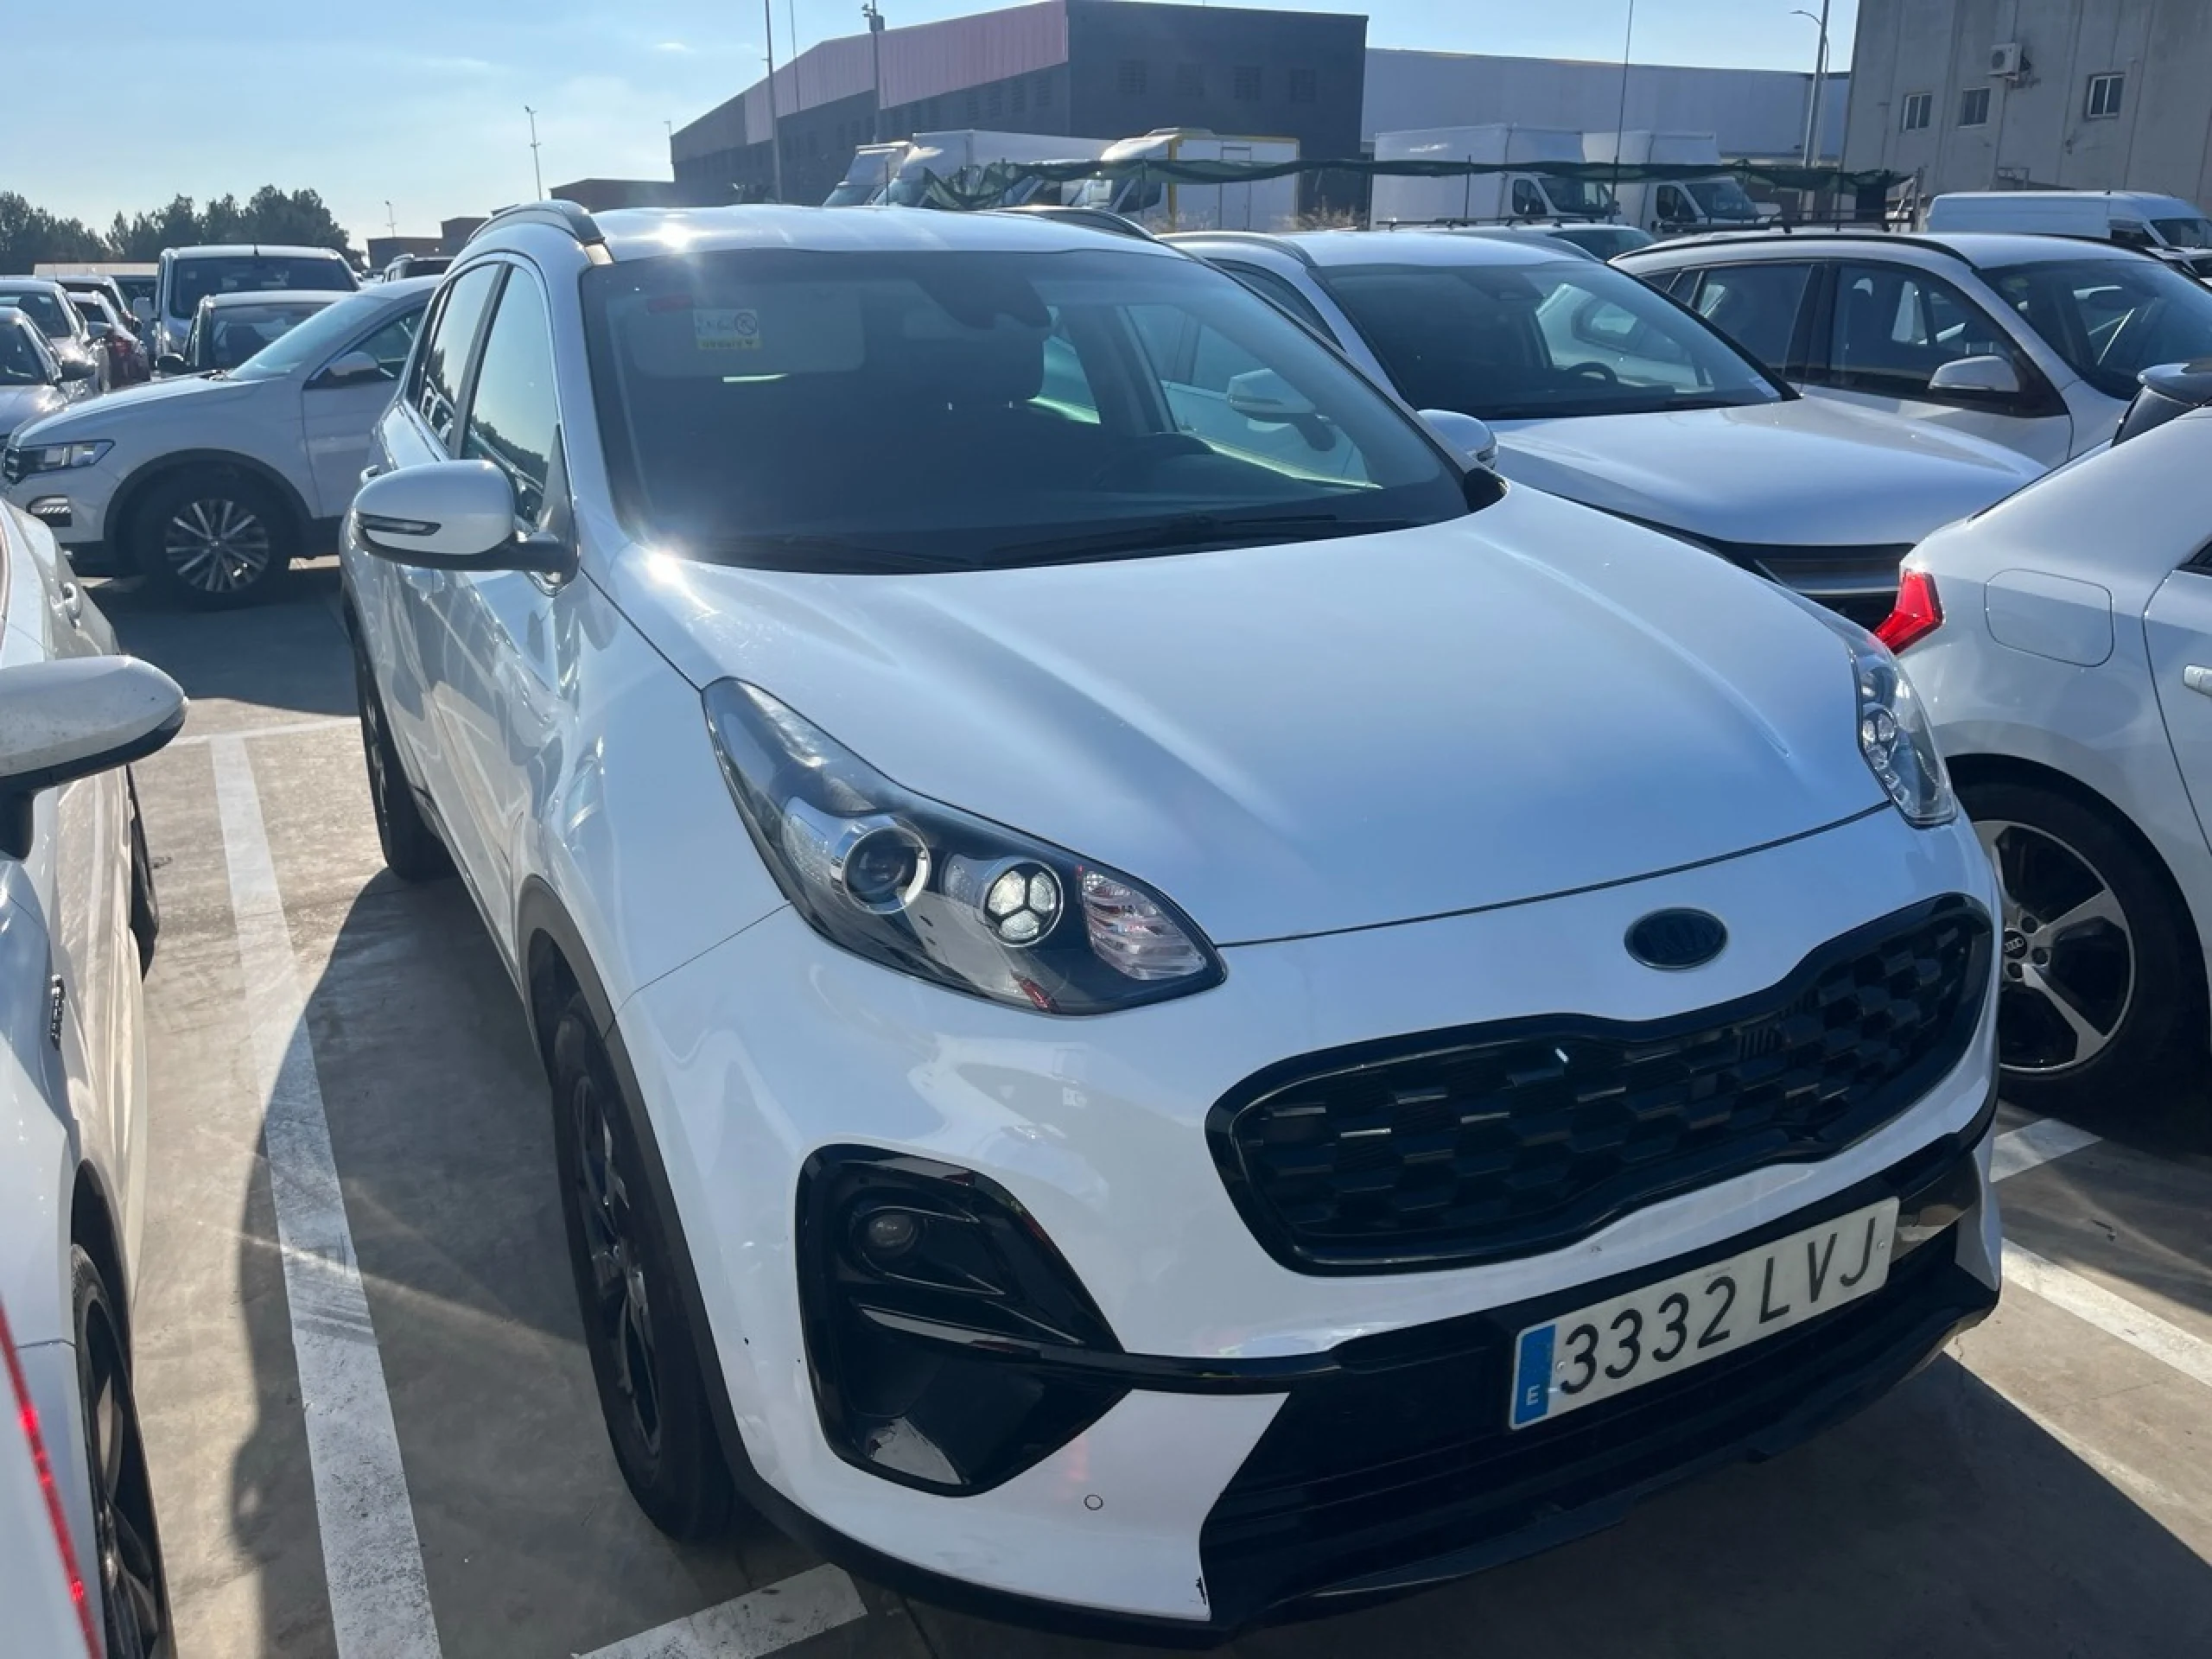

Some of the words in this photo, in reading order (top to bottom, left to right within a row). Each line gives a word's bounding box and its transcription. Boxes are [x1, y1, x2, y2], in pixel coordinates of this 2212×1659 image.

[1560, 1275, 1737, 1394] 3332
[1759, 1217, 1876, 1325] LVJ
[1526, 1383, 1539, 1407] E
